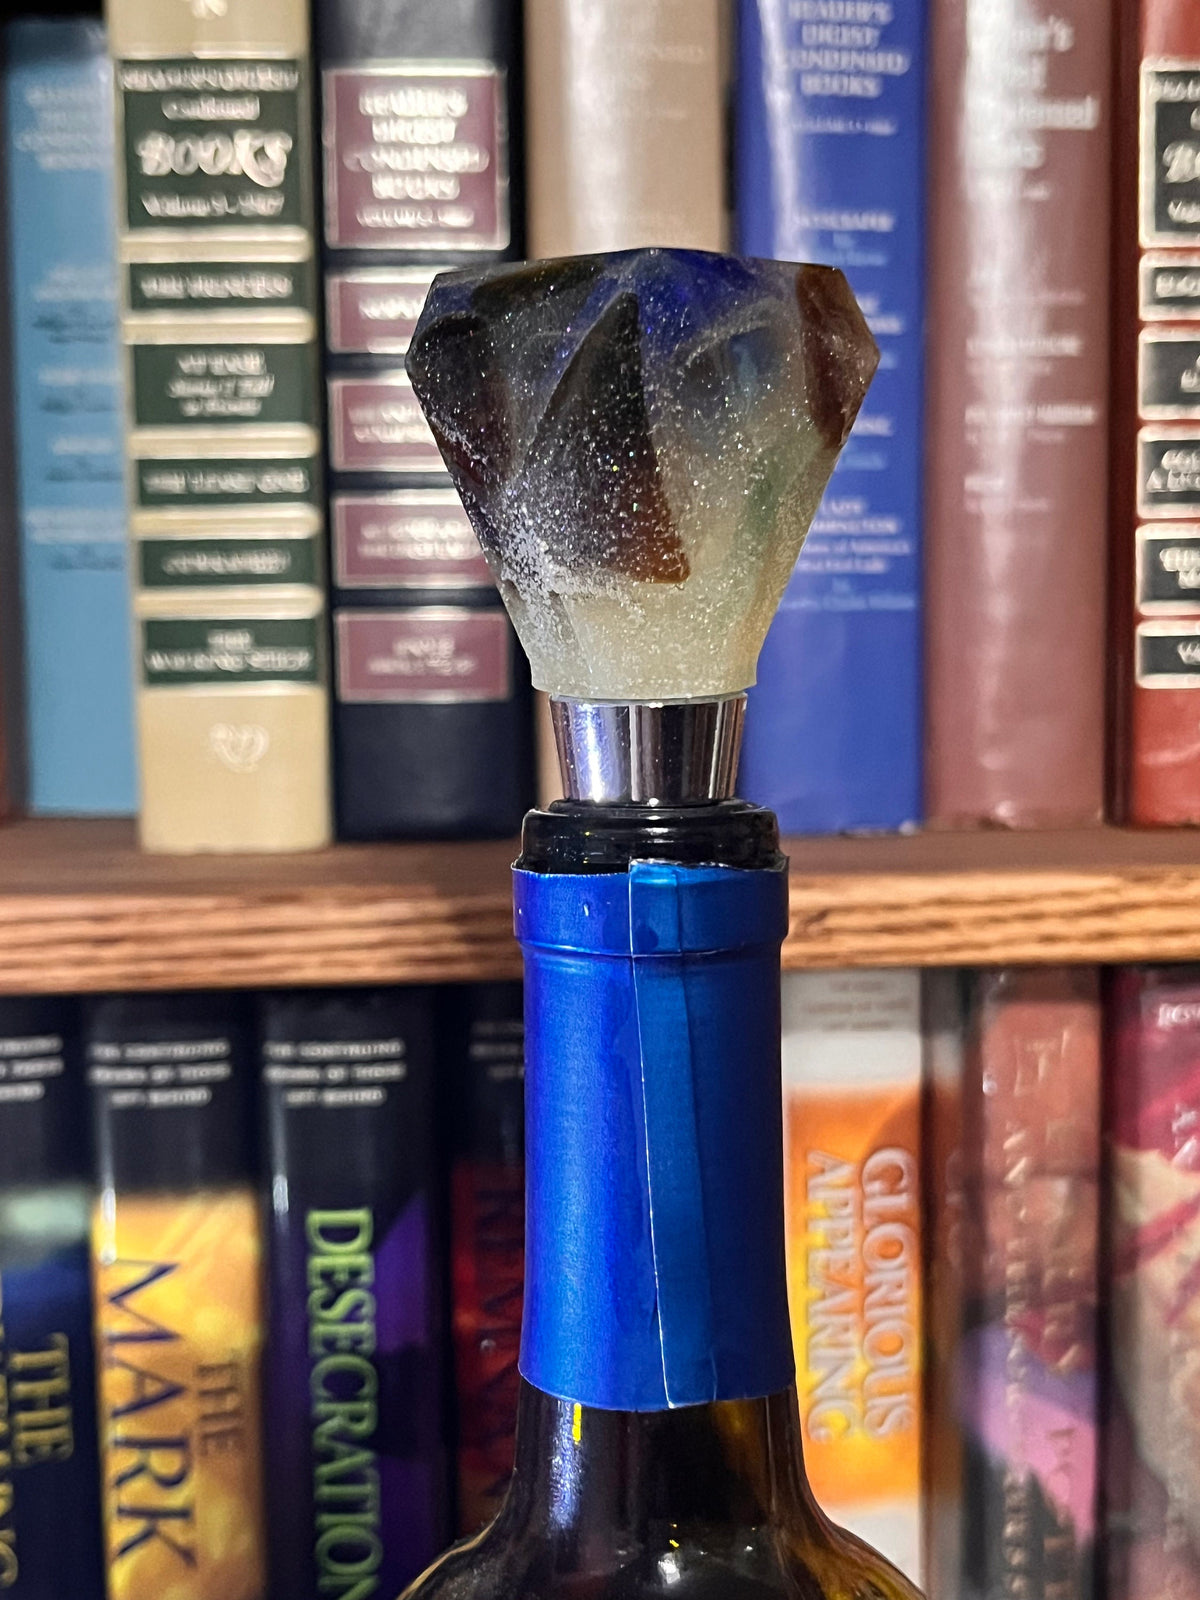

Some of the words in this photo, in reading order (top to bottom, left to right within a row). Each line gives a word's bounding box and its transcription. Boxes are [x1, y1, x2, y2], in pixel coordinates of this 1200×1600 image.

[7, 1331, 75, 1469] THE
[103, 1255, 199, 1568] MARK
[195, 1347, 248, 1458] THE
[806, 1148, 863, 1444] APPEARING
[861, 1146, 920, 1440] GLORIOUS
